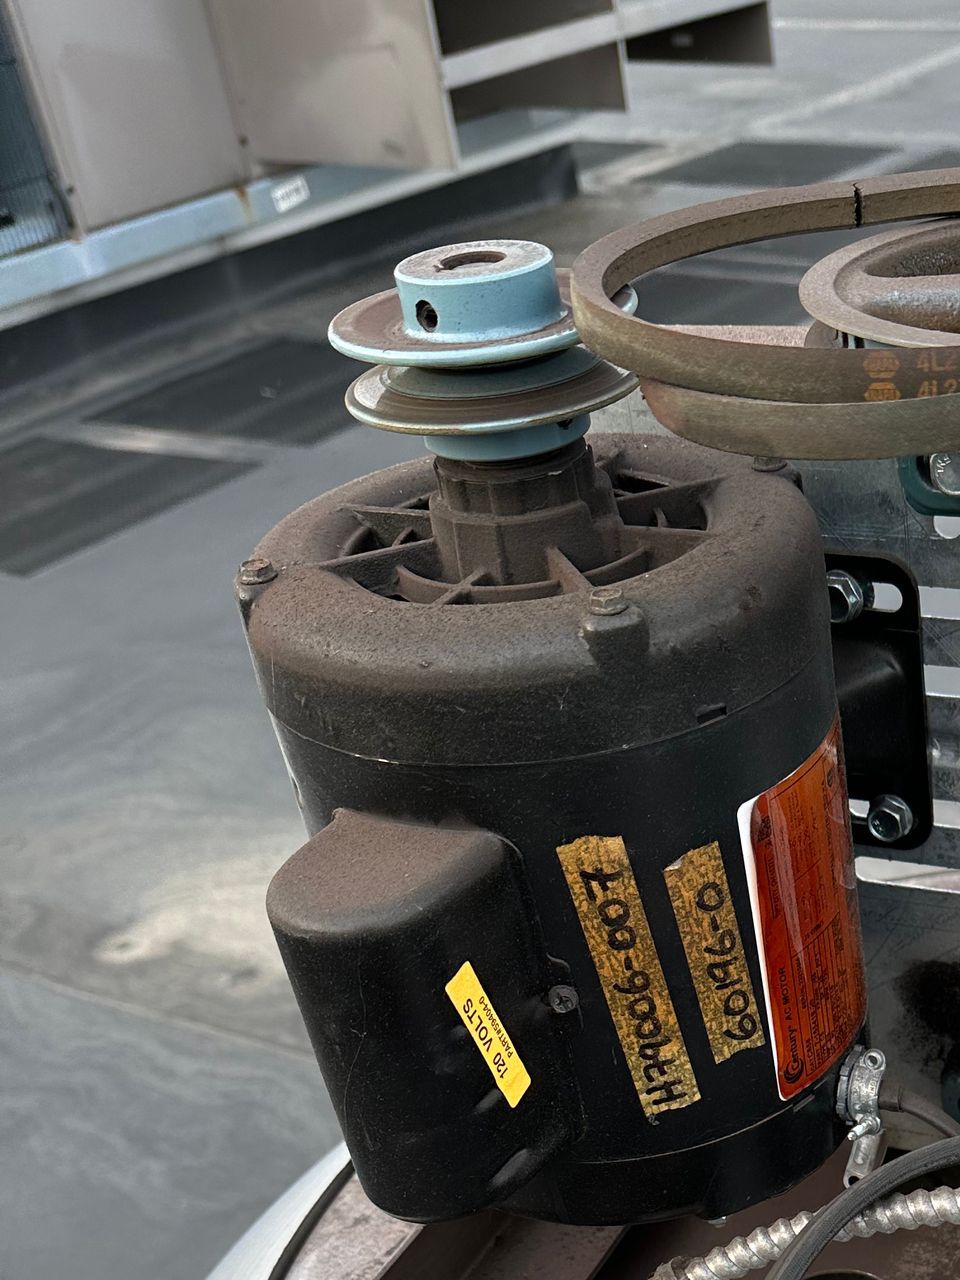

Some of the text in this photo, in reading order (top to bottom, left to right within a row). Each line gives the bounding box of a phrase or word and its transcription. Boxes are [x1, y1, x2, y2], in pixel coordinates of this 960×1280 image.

[578, 867, 688, 1106] H79006-007
[696, 881, 758, 1041] 60196-0
[778, 967, 803, 1078] Century AC MOTOR
[463, 998, 509, 1079] 120 VOLTS
